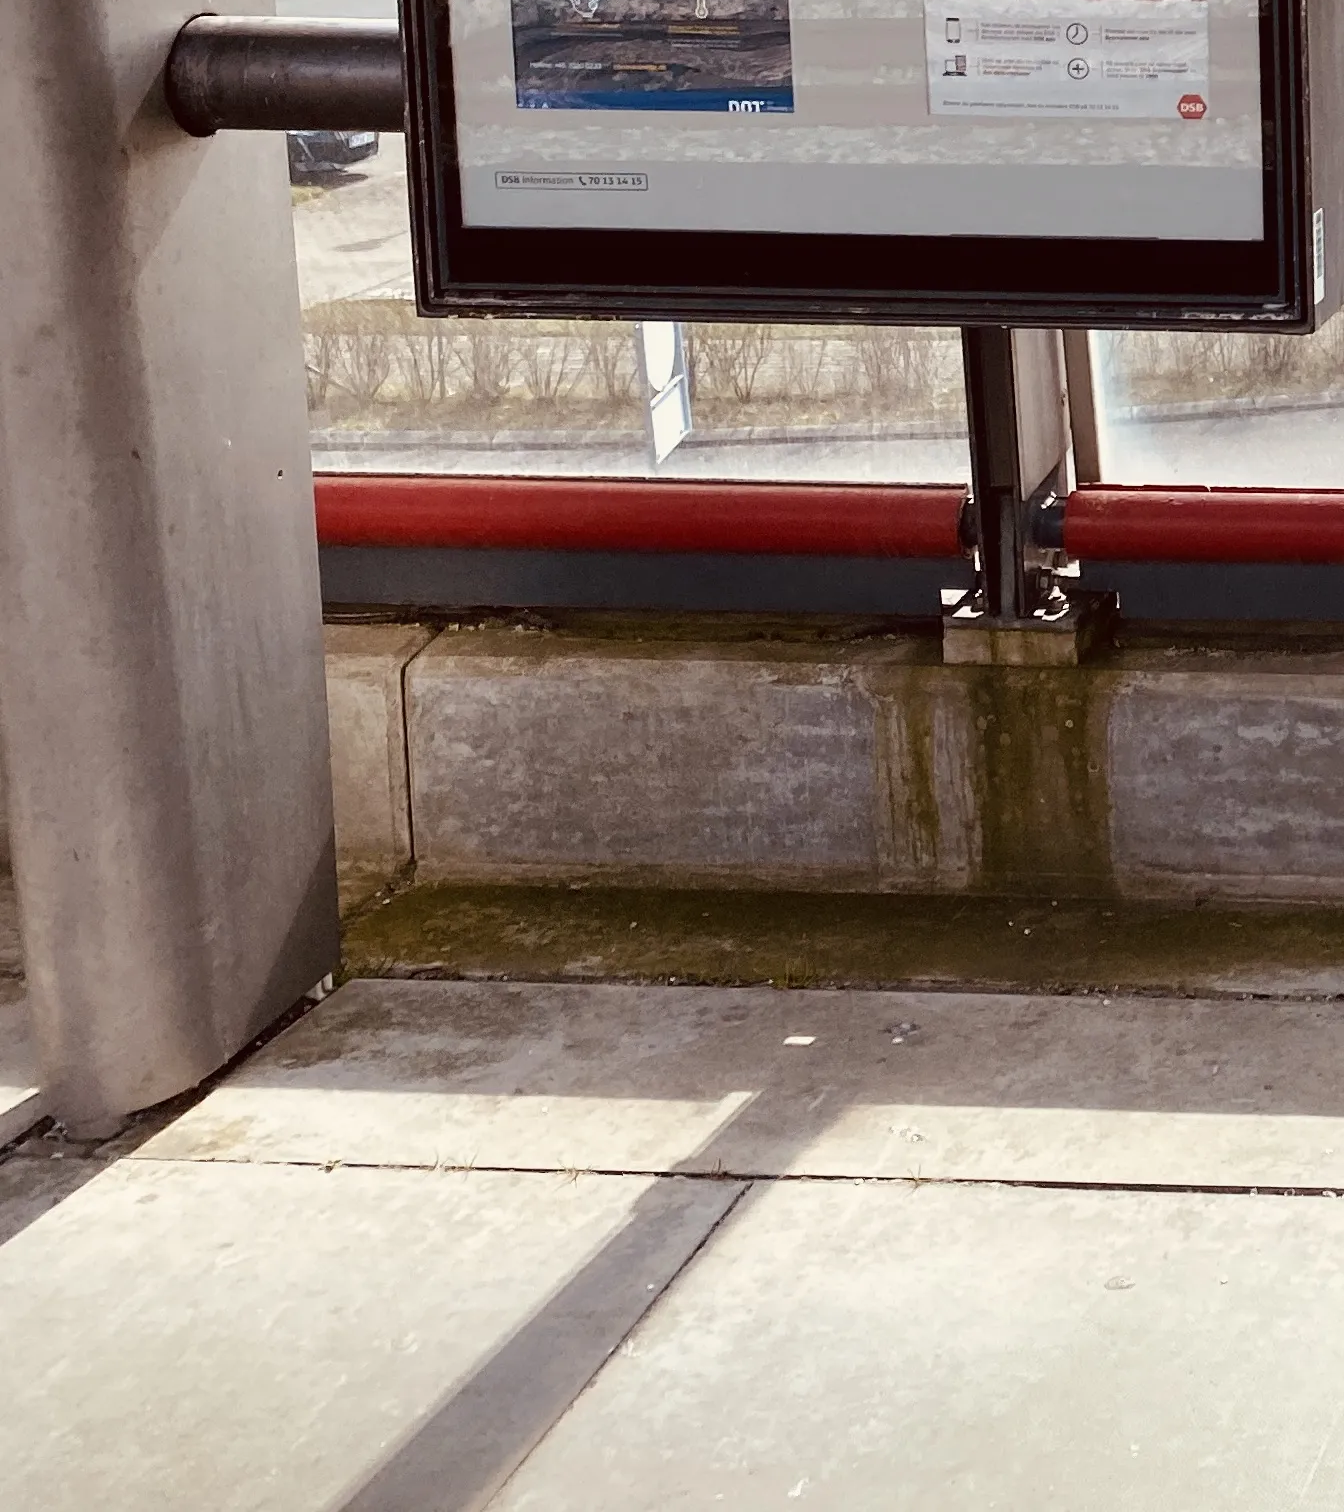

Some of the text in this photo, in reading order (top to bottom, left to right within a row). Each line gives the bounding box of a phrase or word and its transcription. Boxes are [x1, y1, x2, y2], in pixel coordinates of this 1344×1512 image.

[1180, 102, 1204, 113] DSB
[501, 175, 520, 185] DSB
[588, 176, 600, 186] 70
[603, 176, 613, 186] 13
[617, 176, 629, 186] 14
[631, 176, 643, 186] 15
